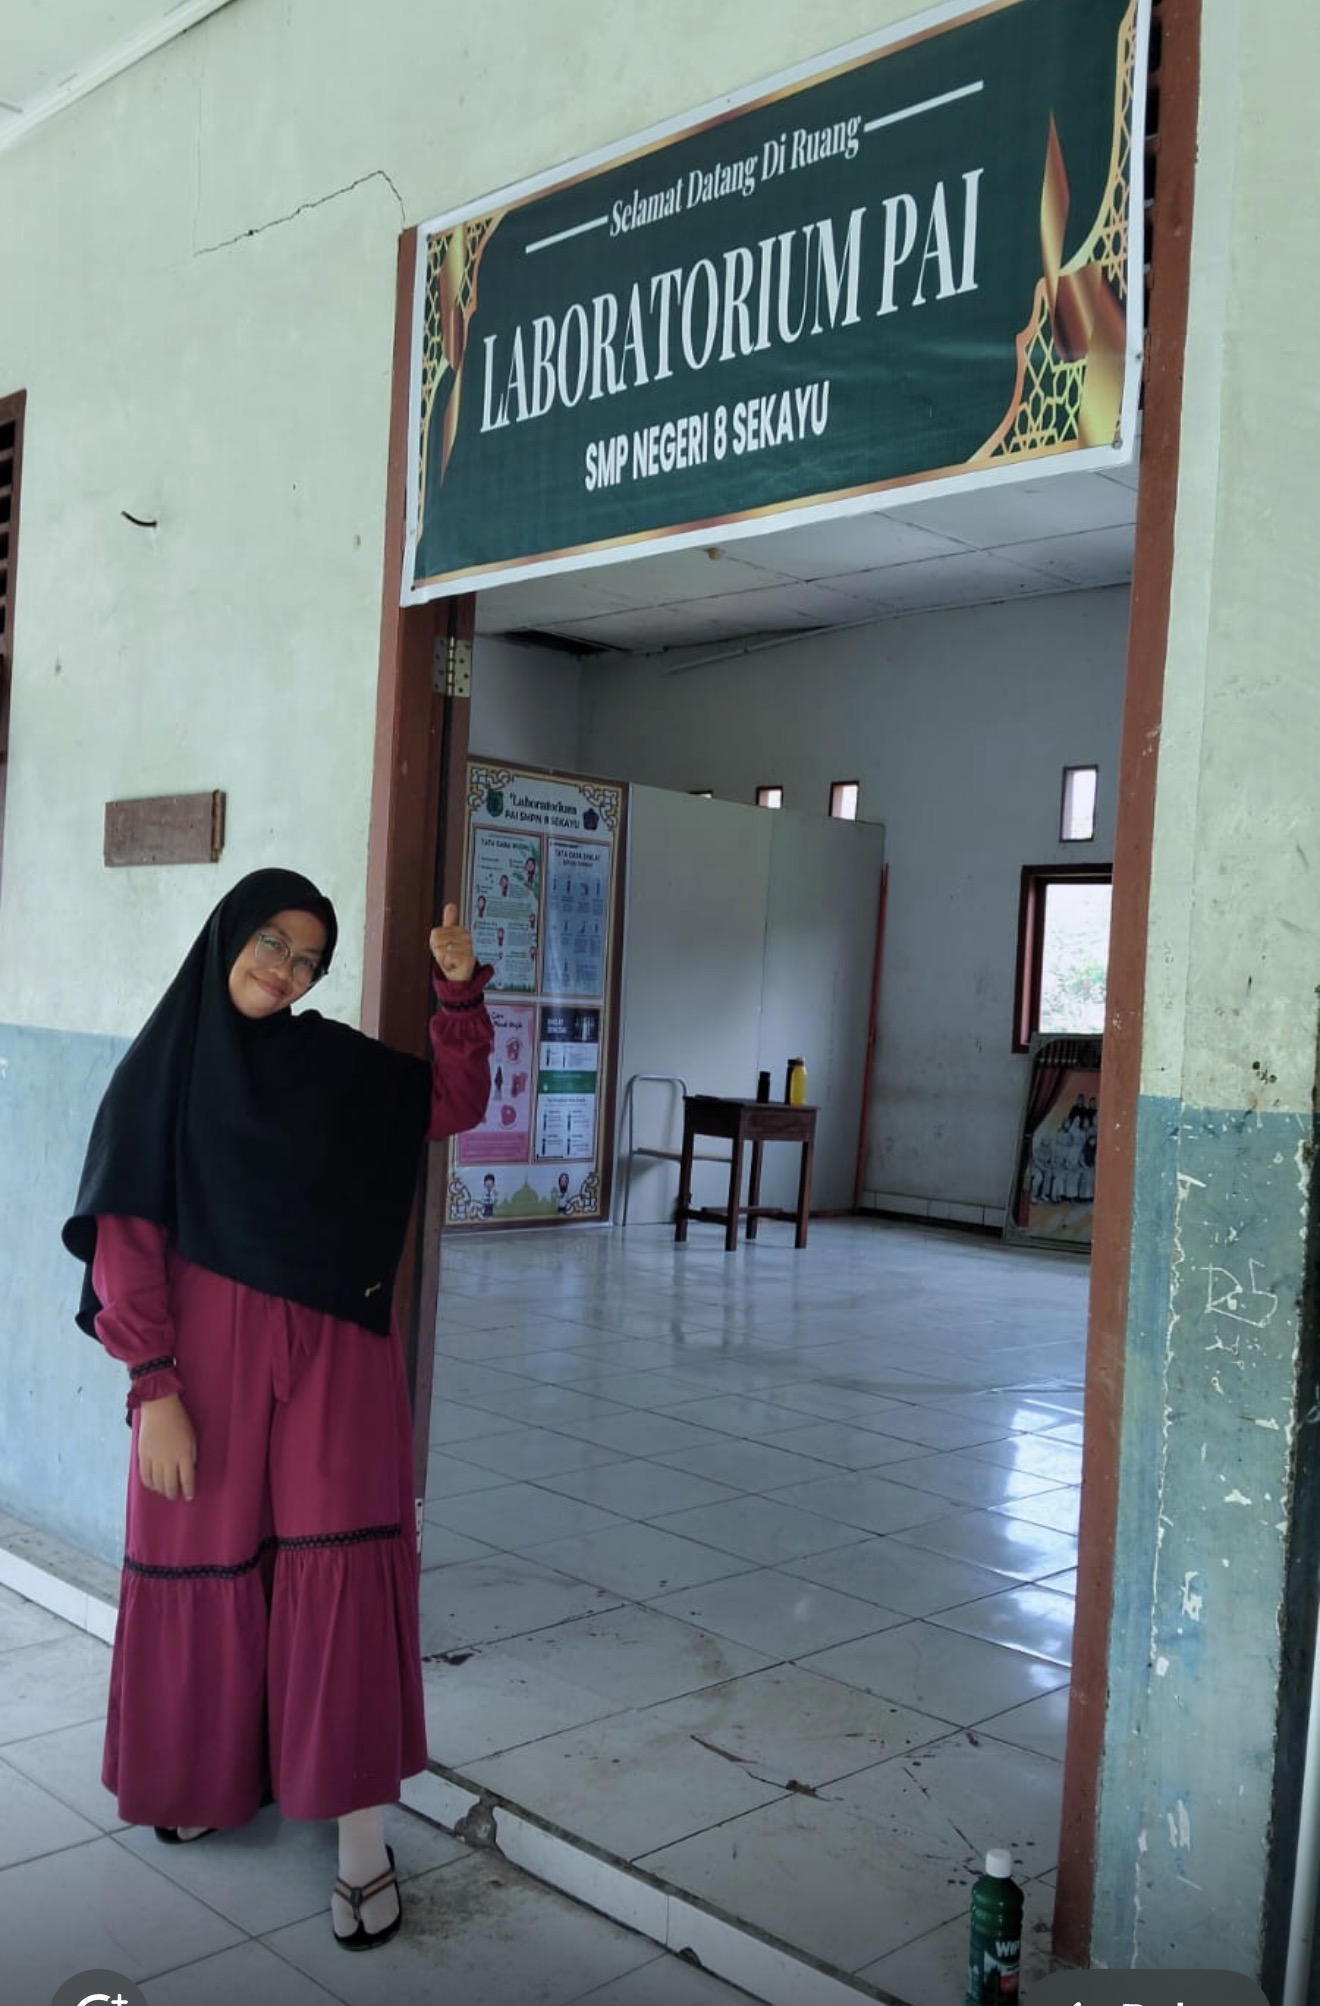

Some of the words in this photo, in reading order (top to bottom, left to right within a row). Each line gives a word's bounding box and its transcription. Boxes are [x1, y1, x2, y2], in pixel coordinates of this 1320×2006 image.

[609, 177, 684, 237] Selamat
[686, 153, 758, 209] Datang
[761, 130, 786, 182] Di
[790, 115, 862, 168] Ruang
[480, 206, 868, 433] LABORATORIUM
[876, 167, 984, 317] PAI
[584, 432, 630, 491] SMP
[632, 413, 708, 480] NEGERI
[712, 404, 728, 461] 8
[731, 378, 831, 455] SEKAYU
